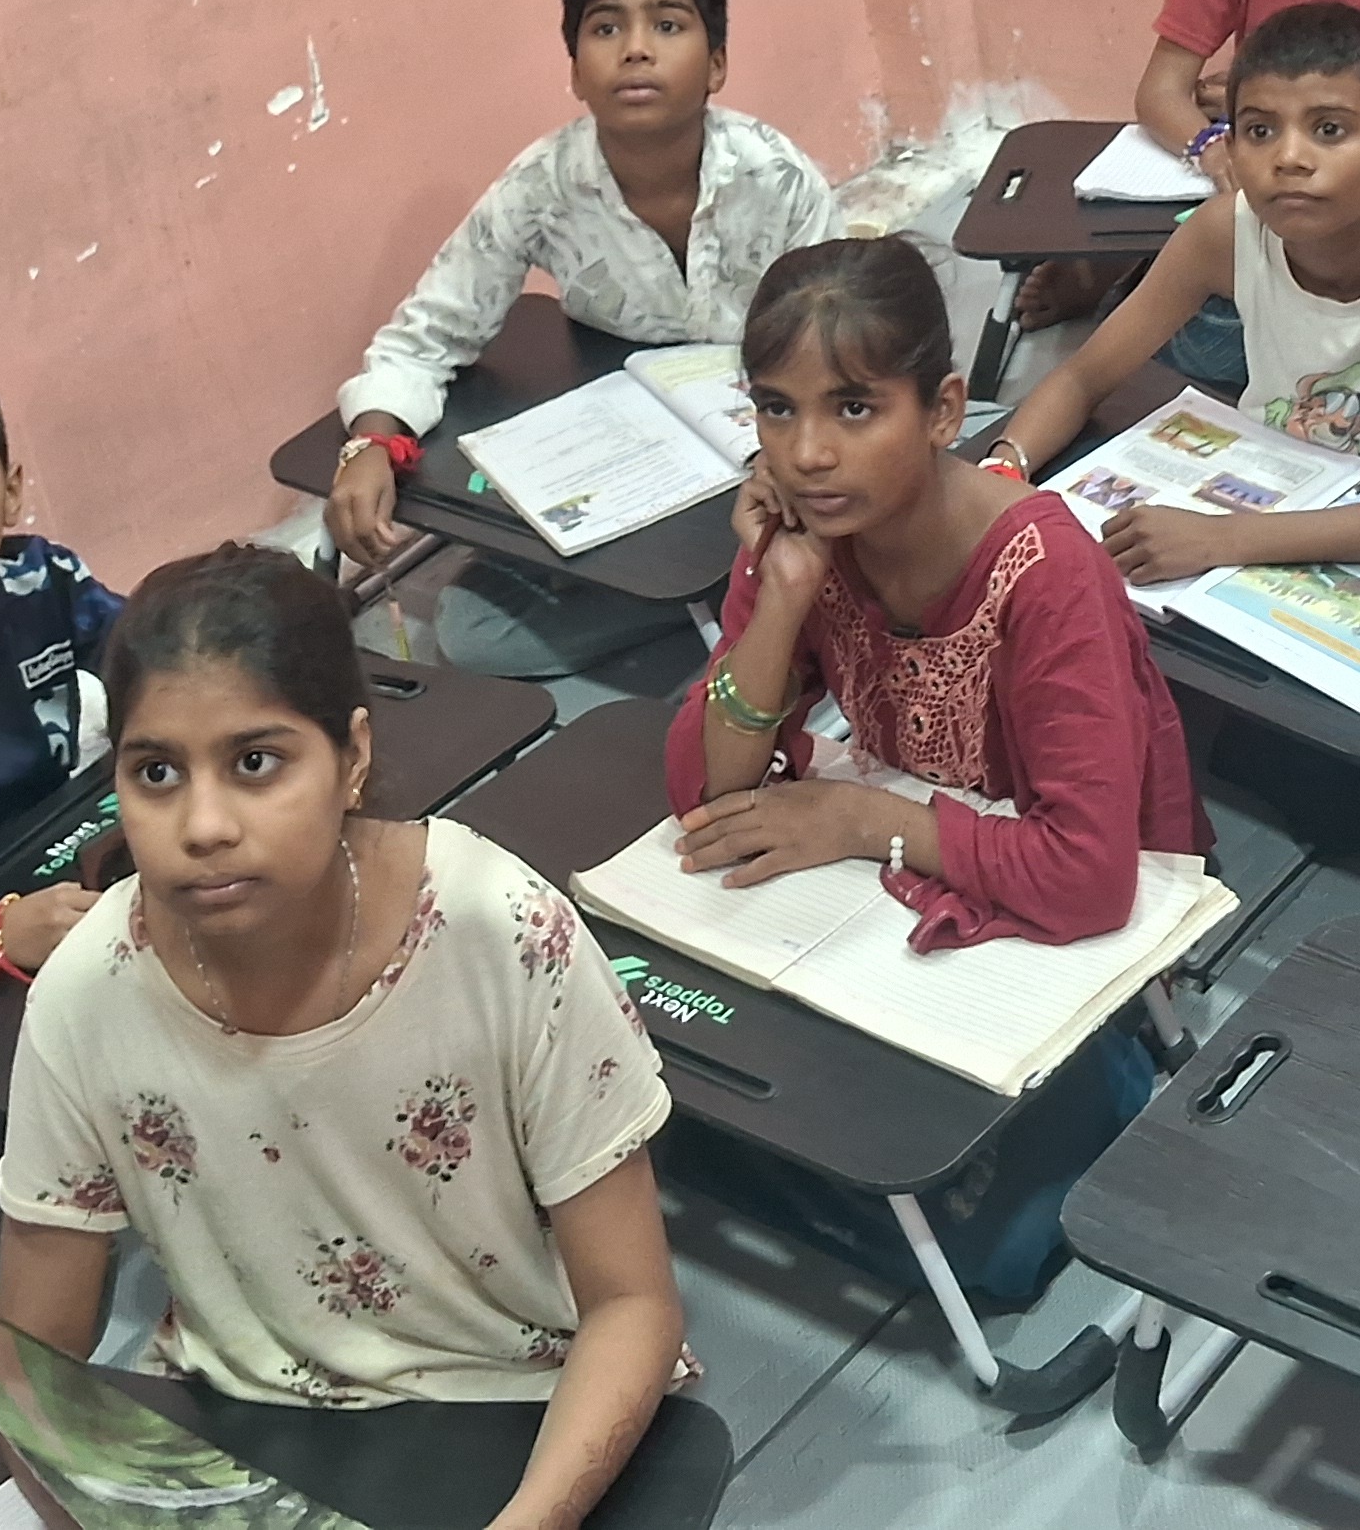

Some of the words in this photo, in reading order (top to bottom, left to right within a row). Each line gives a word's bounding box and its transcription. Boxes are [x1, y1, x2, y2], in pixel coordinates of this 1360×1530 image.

[45, 821, 97, 857] Next
[639, 989, 699, 1023] Next
[643, 975, 735, 1024] Toppers
